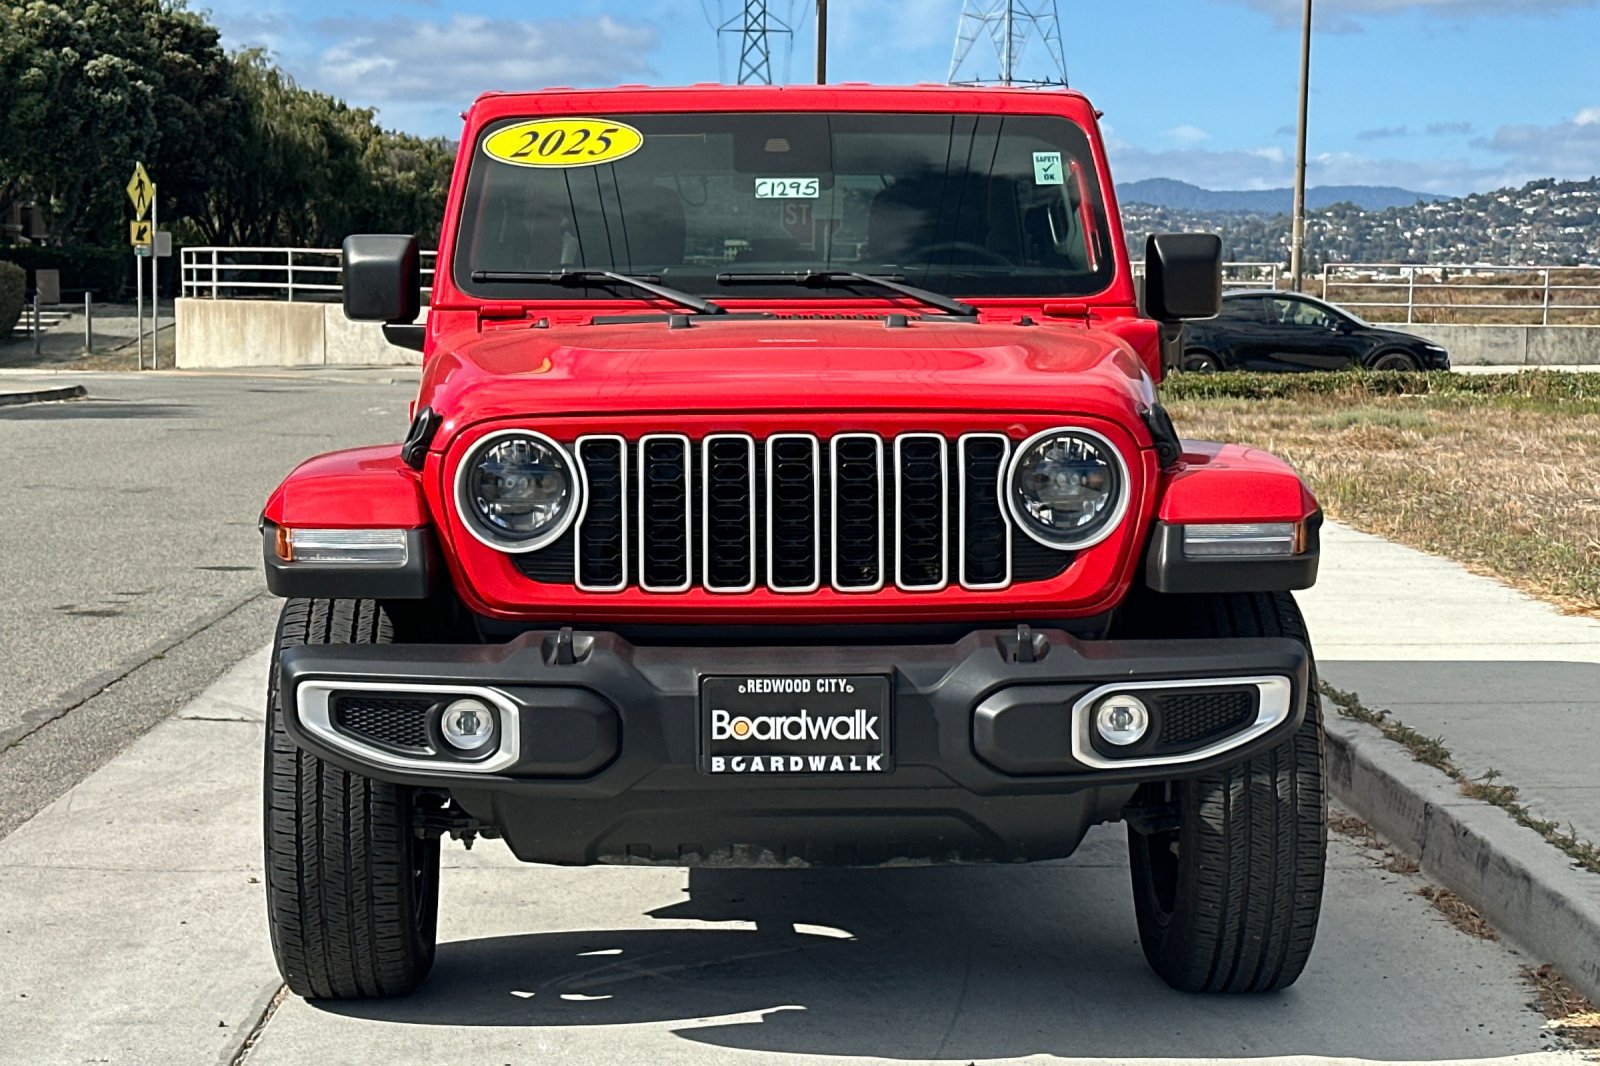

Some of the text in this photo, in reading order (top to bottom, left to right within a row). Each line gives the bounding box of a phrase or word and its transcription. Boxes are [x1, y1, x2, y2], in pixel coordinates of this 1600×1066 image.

[510, 128, 619, 158] 2025
[1035, 155, 1059, 163] SAFETY
[1043, 173, 1055, 181] OK
[755, 181, 818, 197] C1295
[785, 203, 810, 226] ST
[747, 678, 847, 693] REDWOOD CITY
[711, 709, 880, 740] Boardwalk
[711, 755, 882, 772] BOARDWALK
